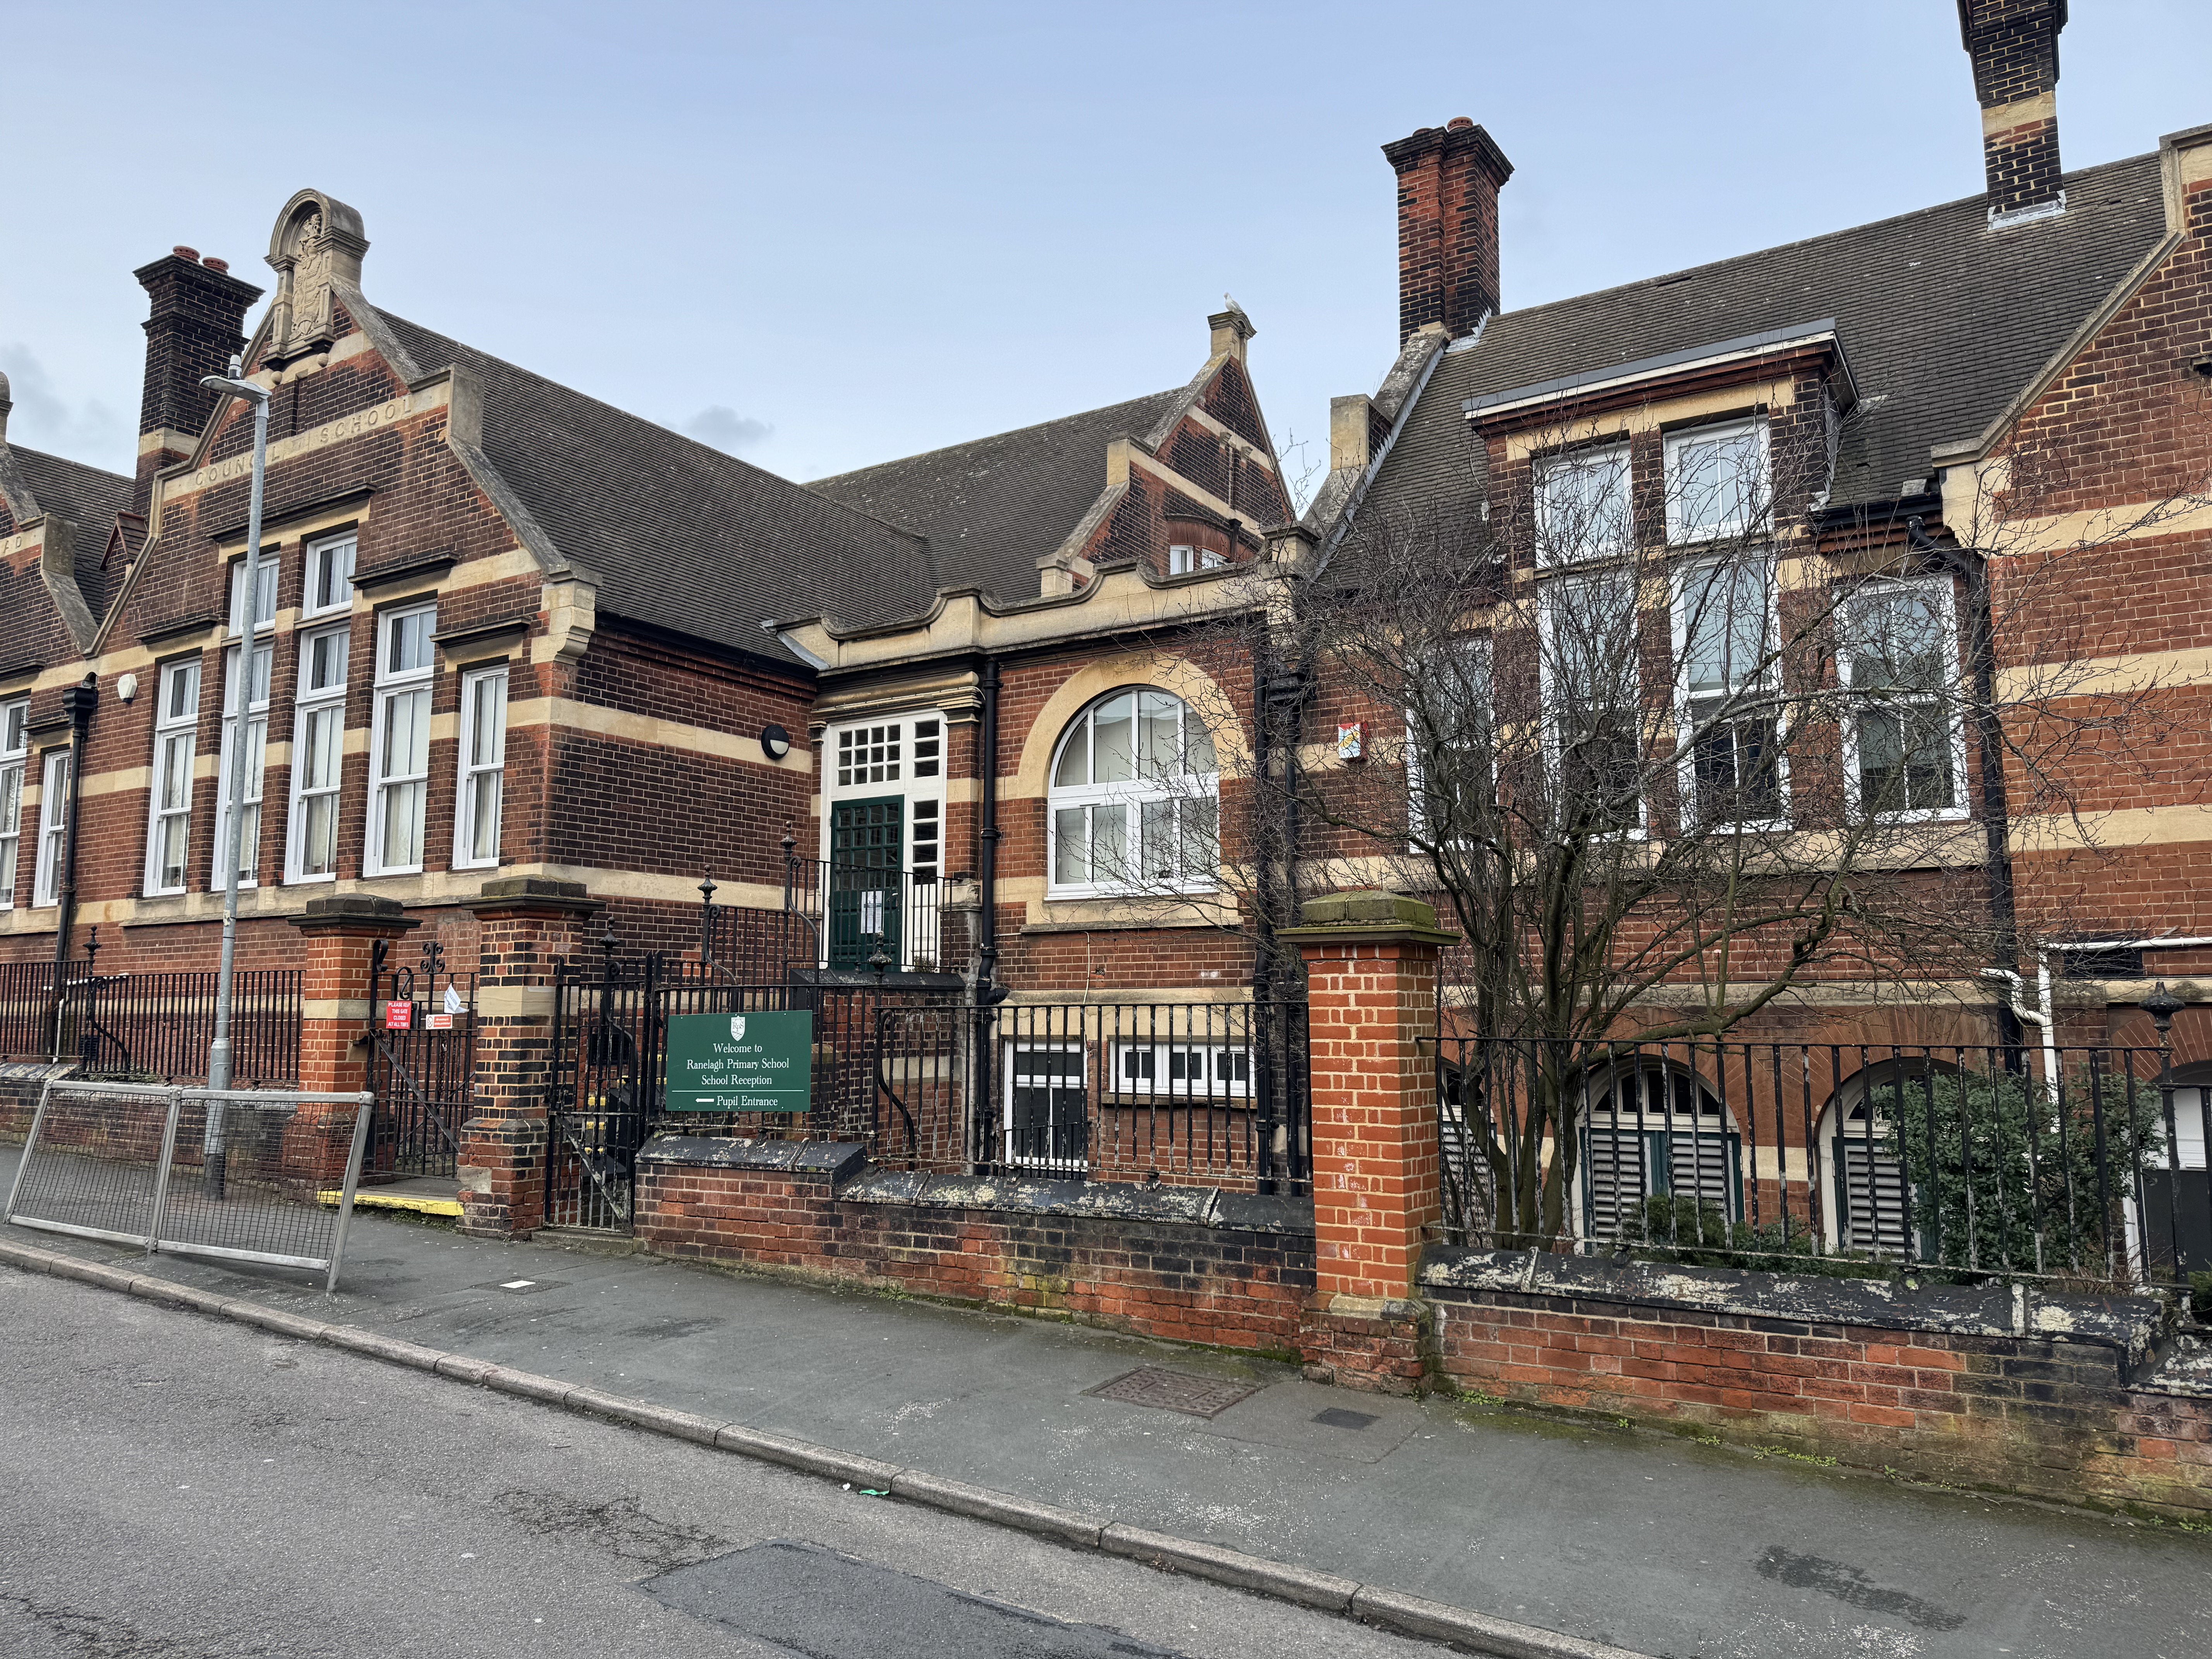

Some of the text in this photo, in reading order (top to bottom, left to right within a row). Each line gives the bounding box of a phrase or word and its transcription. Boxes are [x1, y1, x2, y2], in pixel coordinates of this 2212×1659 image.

[196, 399, 412, 486] COUNCL SCHOOL
[713, 1043, 762, 1053] Welcome to
[687, 1058, 789, 1072] Ranelagh Primary School
[702, 1075, 772, 1087] School Reception
[717, 1096, 778, 1109] Pupil Entrance
